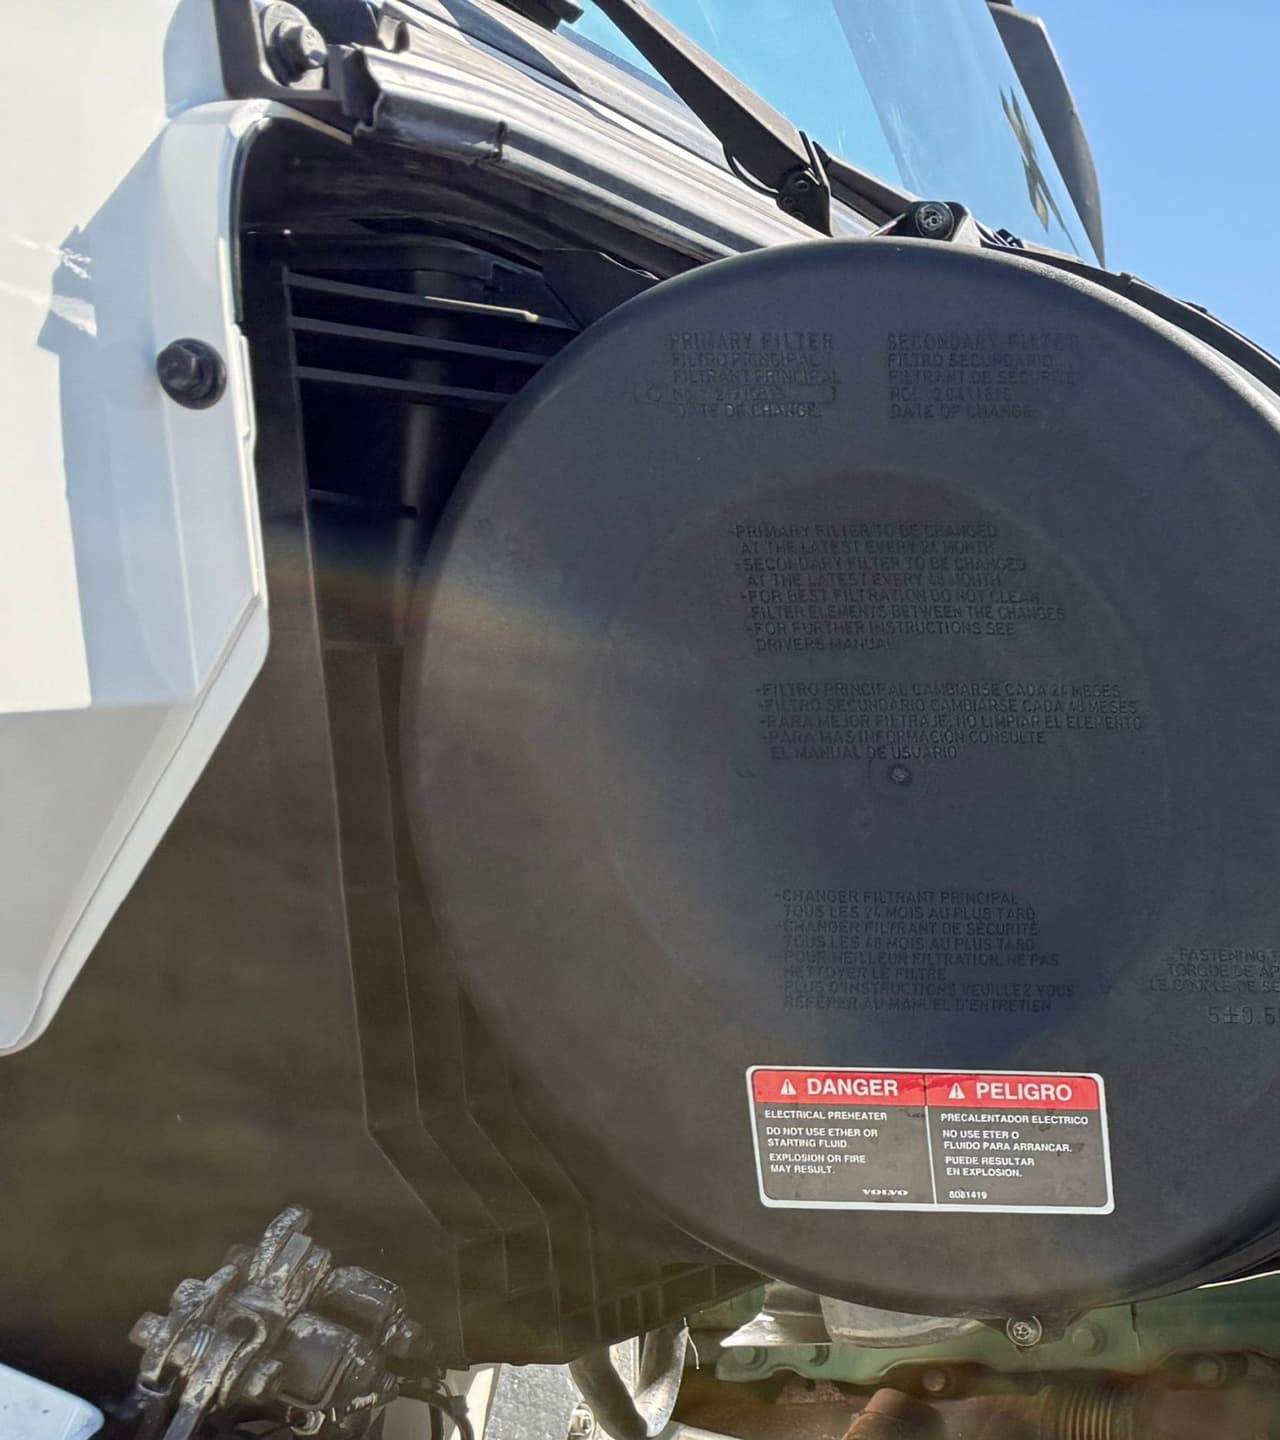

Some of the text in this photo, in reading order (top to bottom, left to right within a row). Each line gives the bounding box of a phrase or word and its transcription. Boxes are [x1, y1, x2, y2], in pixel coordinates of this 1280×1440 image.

[760, 331, 834, 350] FILTER
[791, 621, 865, 635] FURTHER
[869, 621, 982, 635] INSTRUCTIONS
[985, 621, 1016, 635] SEE
[823, 682, 908, 697] PRINCIPAL
[911, 682, 1001, 697] CAMBIARSE
[1004, 682, 1047, 697] CADA
[1072, 682, 1121, 697] MESES
[957, 714, 978, 730] NO
[981, 714, 1042, 730] LIMPIAR
[1045, 714, 1062, 730] EL
[968, 730, 1046, 745] CONSULTE
[865, 746, 887, 760] DE
[890, 746, 958, 760] USUARIO
[863, 890, 936, 905] FILTRANT
[940, 890, 1019, 905] PRINCIPAL
[784, 905, 825, 920] TOUS
[829, 905, 861, 920] LES
[887, 905, 924, 920] MOIS
[928, 905, 950, 920] AU
[953, 905, 993, 920] PLUS
[864, 921, 938, 936] FILTRANT
[941, 921, 962, 936] DE
[887, 936, 925, 951] MOIS
[929, 936, 951, 951] AU
[954, 936, 994, 951] PLUS
[807, 1079, 899, 1097] DANGER
[975, 1082, 1072, 1102] PELIGRO
[765, 1109, 888, 1121] ELECTRICAL PREHEATER
[940, 1113, 1089, 1126] PRECALENTADOR ELECTRICO
[766, 1126, 878, 1138] DO NOT USE ETHER OR
[942, 1129, 1021, 1141] NO USE ETER O
[767, 1138, 816, 1149] STARTING
[943, 1141, 1073, 1153] FLUIDO PARA ARRANCAR.
[769, 1153, 867, 1165] EXPLOSION OR FIRE
[945, 1155, 1035, 1168] PUEDE RESULTAR
[770, 1165, 792, 1175] MAY
[946, 1167, 1024, 1179] EN EXPLOSION.
[862, 1188, 909, 1197] VOLVO
